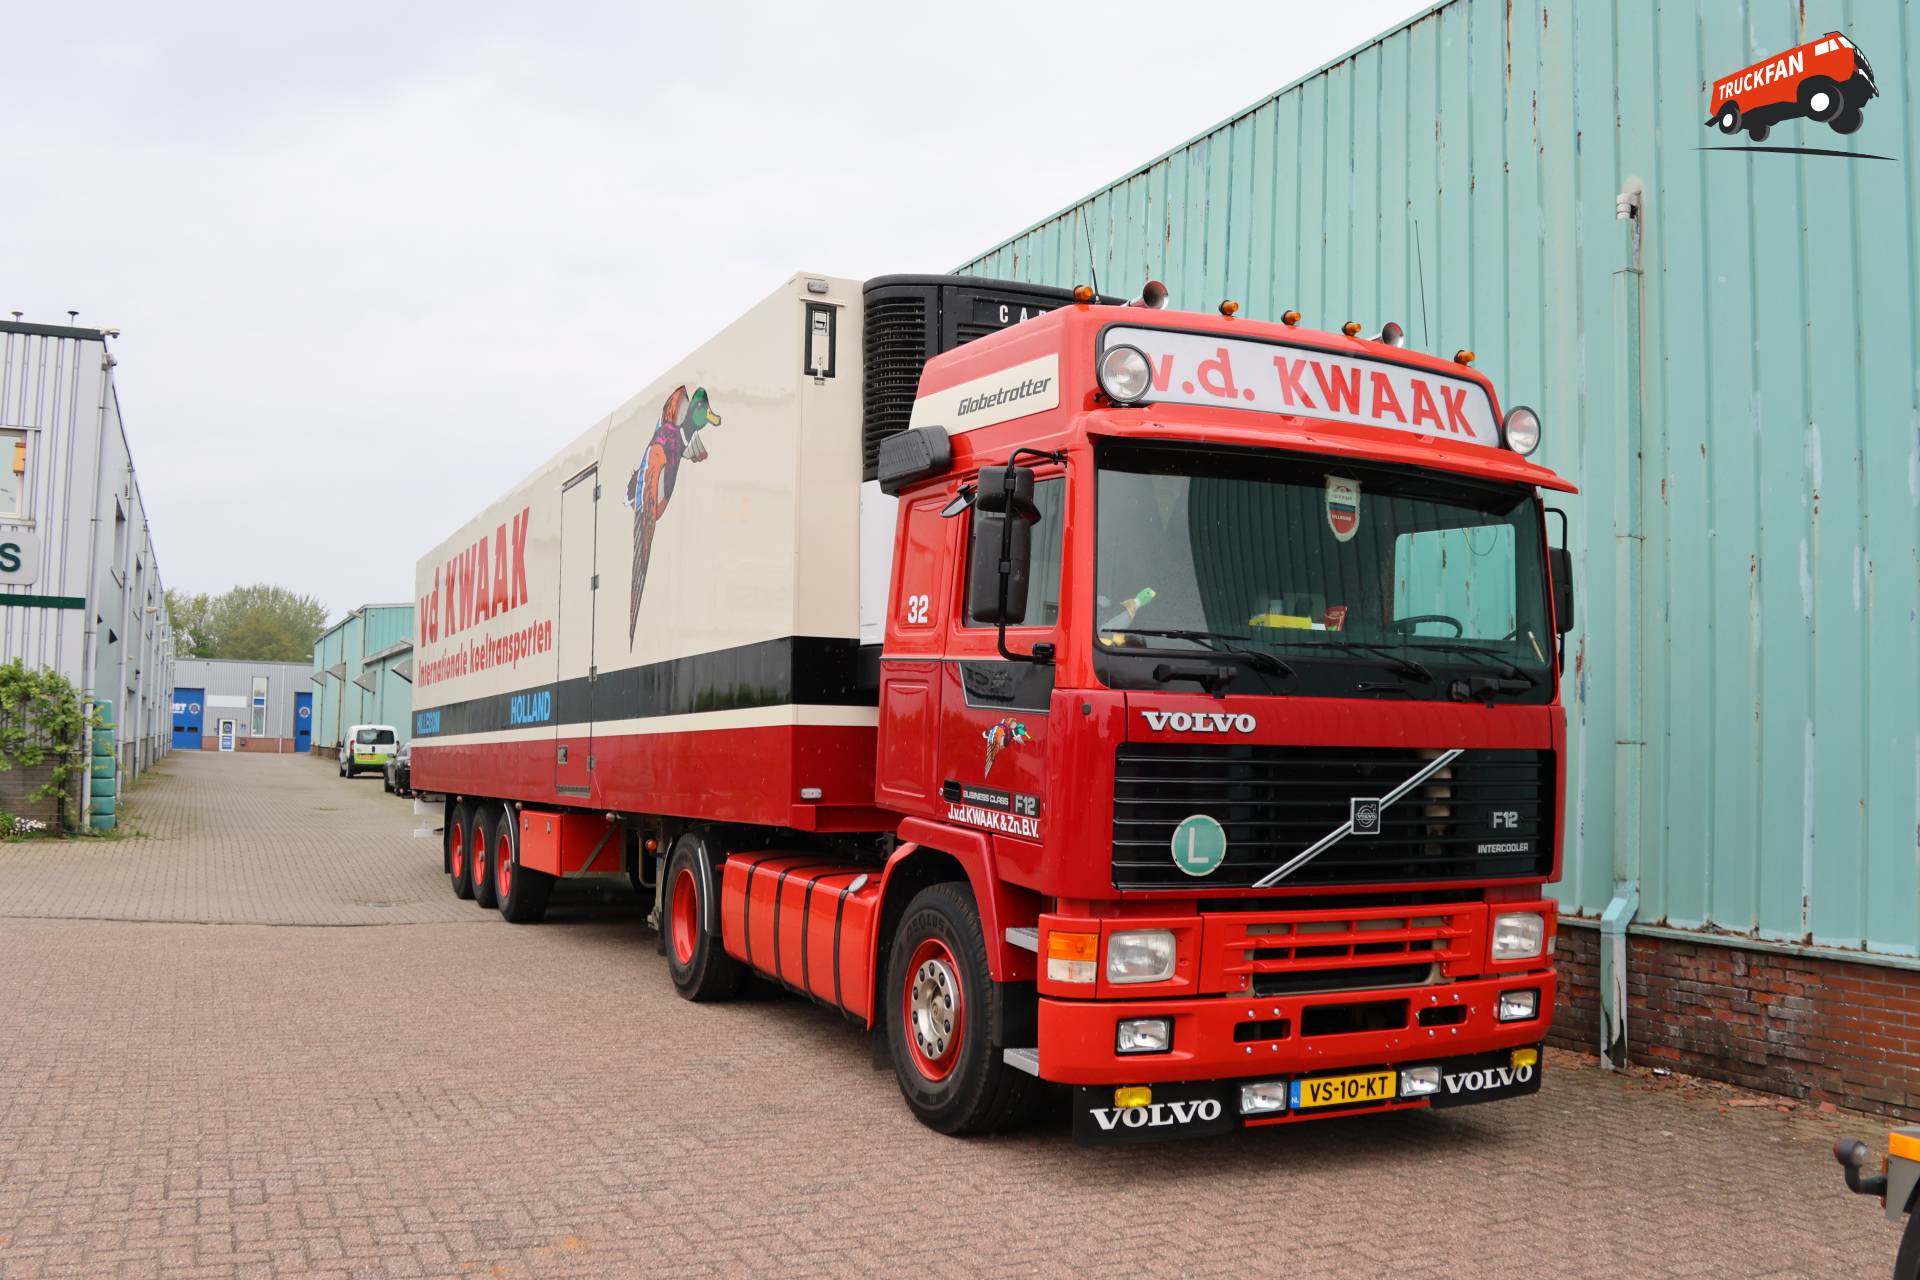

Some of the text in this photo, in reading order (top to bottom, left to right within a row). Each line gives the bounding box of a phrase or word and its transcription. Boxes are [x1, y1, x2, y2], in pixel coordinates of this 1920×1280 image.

[957, 377, 1052, 416] Globetrotter
[1273, 355, 1477, 438] KWAAK
[444, 506, 530, 638] KWAAK
[907, 594, 929, 624] 32
[511, 691, 551, 725] HOLLAND
[1141, 710, 1257, 734] VOLVO
[963, 790, 1036, 816] BUSINESS CLASS F12
[1493, 810, 1519, 829] F12
[1187, 826, 1210, 863] L
[1477, 842, 1529, 854] INTERCOOLER
[1310, 1076, 1388, 1103] VS-10-KT
[1443, 1063, 1533, 1094] VOLVO
[1090, 1099, 1222, 1131] VOLVO
[1291, 1096, 1299, 1104] NL
